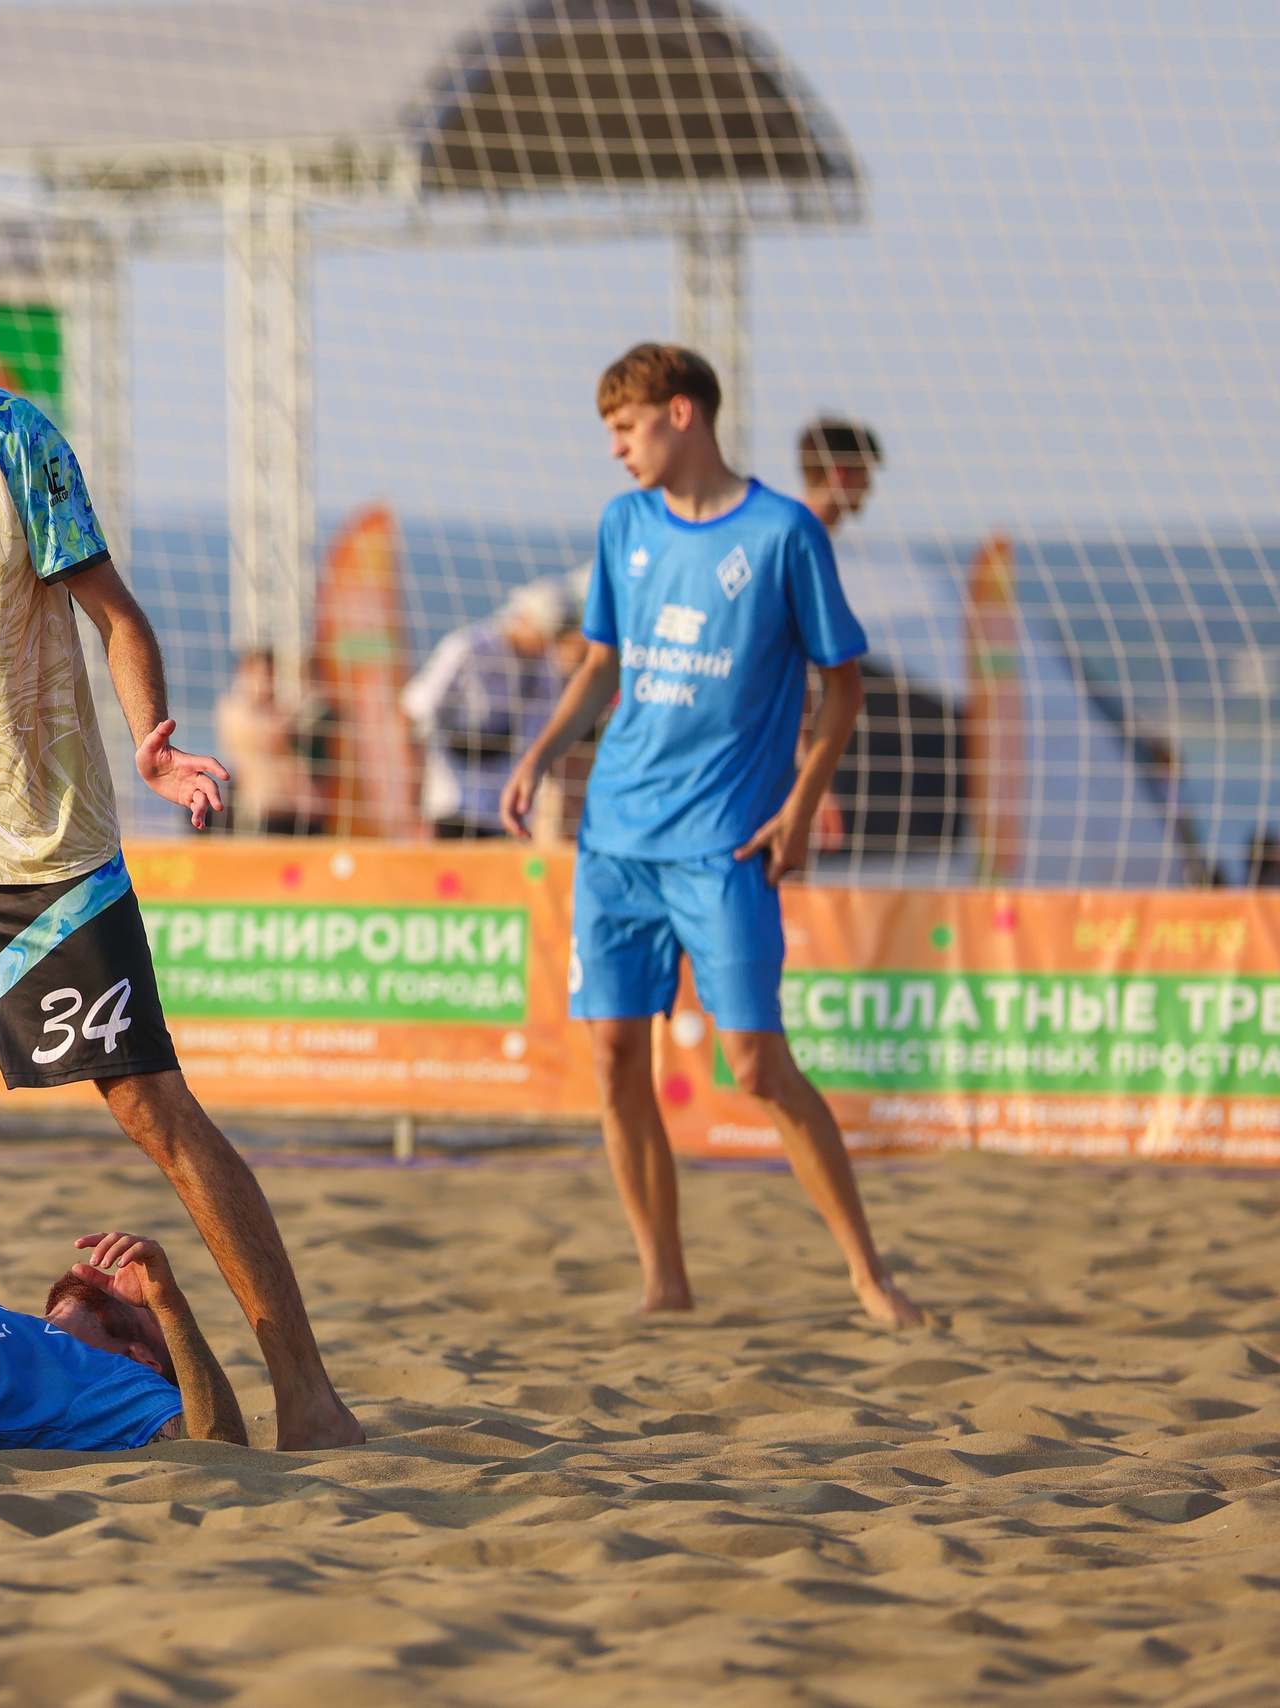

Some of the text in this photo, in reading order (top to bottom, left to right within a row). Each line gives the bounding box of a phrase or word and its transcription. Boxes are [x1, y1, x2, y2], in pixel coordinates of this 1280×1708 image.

[633, 672, 698, 708] банк
[142, 910, 522, 962] ТРЕНИРОВКИ
[376, 970, 527, 1010] ГОРОДА
[780, 977, 1157, 1034] ЕСПЛАТНЫЕ
[31, 977, 132, 1065] 34
[789, 1037, 1099, 1078] ОБЩЕСТВЕННЫХ
